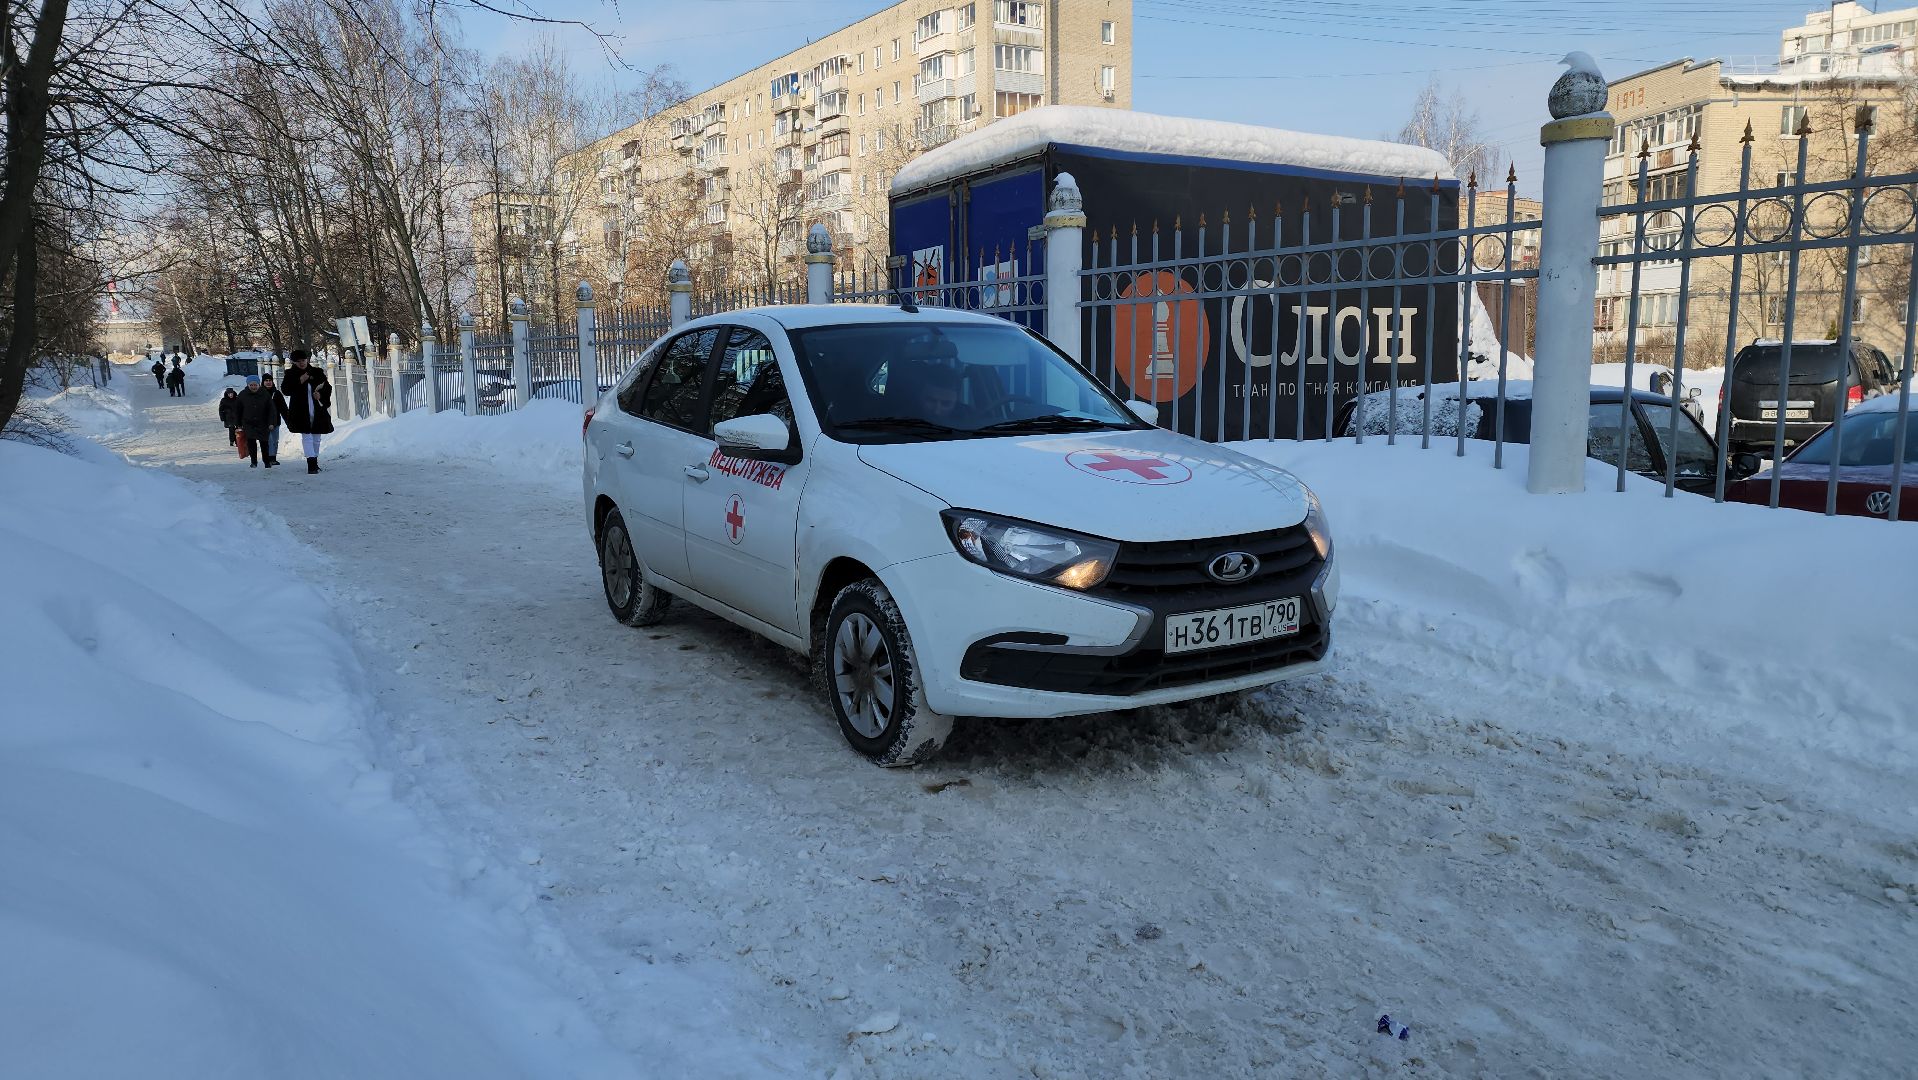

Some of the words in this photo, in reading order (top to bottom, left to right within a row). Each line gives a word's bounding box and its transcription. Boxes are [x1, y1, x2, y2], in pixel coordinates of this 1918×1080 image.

[1615, 87, 1645, 111] 1973
[708, 447, 786, 490] МЕДСЛУЖБА
[1267, 601, 1296, 625] 790
